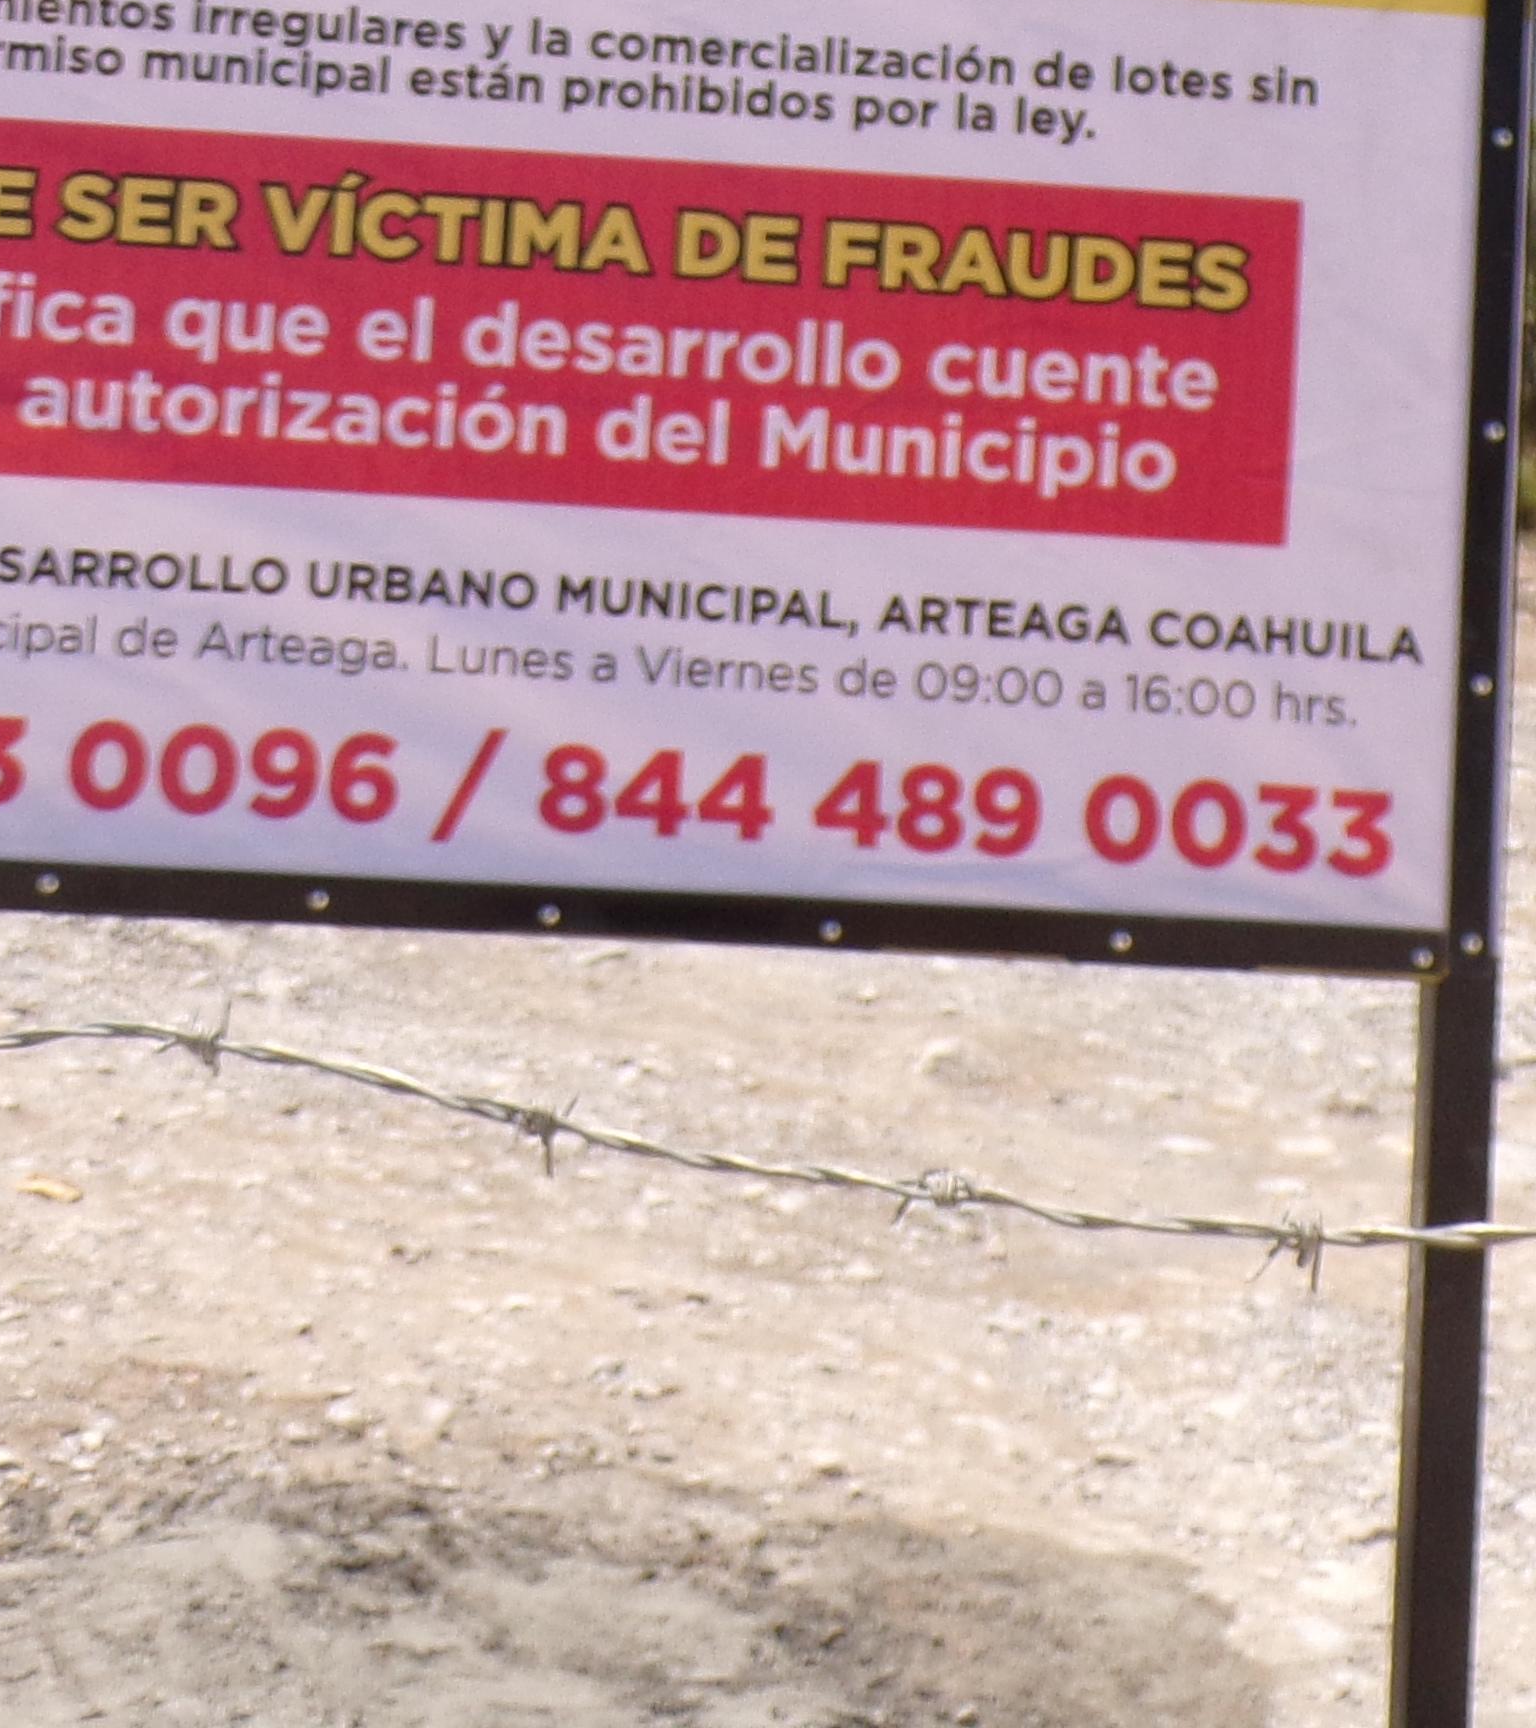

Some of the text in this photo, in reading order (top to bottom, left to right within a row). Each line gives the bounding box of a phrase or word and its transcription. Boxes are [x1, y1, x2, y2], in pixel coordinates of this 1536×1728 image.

[141, 45, 392, 99] municipal
[407, 61, 546, 105] están
[560, 70, 836, 123] prohibidos
[850, 94, 941, 133] por
[954, 90, 998, 134] la
[1014, 94, 1097, 147] ley.
[483, 22, 513, 62] y
[528, 15, 573, 59] la
[587, 29, 1017, 87] comercialización
[1031, 49, 1097, 92] de
[1112, 54, 1234, 102] lotes
[1249, 64, 1319, 108] sin
[56, 173, 239, 248] SER
[263, 172, 650, 275] VÍCTIMA
[674, 210, 801, 284] DE
[823, 220, 1249, 311] FRAUDES
[163, 296, 331, 365] que
[355, 294, 437, 365] el
[459, 298, 903, 393] desarrollo
[925, 342, 1220, 413] cuente
[15, 369, 569, 458] autorización
[593, 392, 732, 467] del
[757, 403, 1179, 501] Municipio
[306, 559, 540, 612] URBANO
[555, 573, 860, 640] MUNICIPAL,
[876, 593, 1132, 647] ARTEAGA
[1147, 608, 1424, 667] COAHUILA
[111, 614, 180, 661] de
[192, 619, 410, 679] Arteaga.
[425, 632, 576, 684] Lunes
[587, 651, 620, 686] a
[633, 643, 820, 697] Viernes
[832, 653, 899, 701] de
[910, 659, 1066, 711] 09:00
[1076, 677, 1108, 713] a
[1123, 670, 1258, 722] 16:00
[1270, 679, 1358, 730] hrs.
[67, 719, 400, 826] 0096
[429, 727, 508, 845] /
[536, 743, 775, 844] 844
[811, 759, 1044, 860] 489
[1082, 773, 1395, 881] 0033
